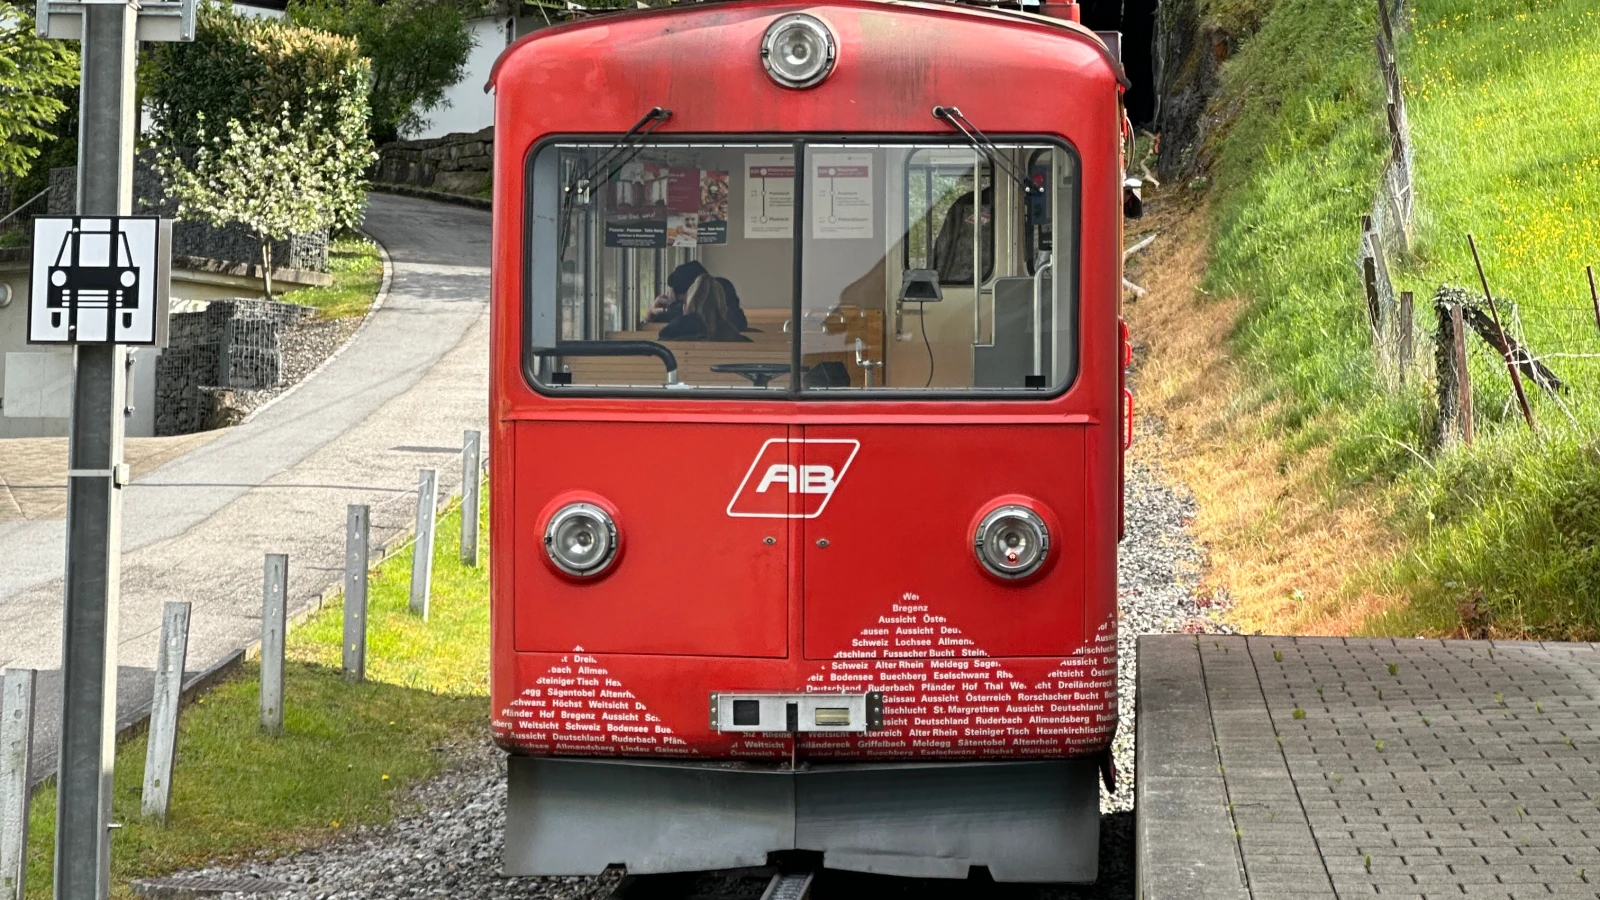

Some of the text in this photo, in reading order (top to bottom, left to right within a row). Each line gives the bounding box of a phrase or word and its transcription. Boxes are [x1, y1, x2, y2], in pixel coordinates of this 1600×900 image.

[755, 464, 835, 493] AB
[892, 604, 928, 613] Bregenz
[878, 615, 916, 624] Aussicht
[940, 626, 962, 634] Deu
[852, 638, 888, 646] Schweiz
[832, 661, 868, 670] Schweiz
[875, 661, 897, 669] Alter
[899, 660, 924, 668] Rhein
[931, 660, 968, 669] Meldegg
[807, 673, 824, 681] eiz
[880, 672, 927, 681] Buechberg
[934, 671, 989, 680] Eselschwanz
[536, 677, 575, 686] Steiniger
[576, 678, 599, 686] Tisch
[1035, 681, 1052, 689] cht
[868, 684, 914, 692] Ruderbach
[921, 683, 955, 691] Pfänder
[962, 682, 978, 690] Hof
[984, 682, 1003, 690] Thal
[522, 689, 541, 697] egg
[548, 688, 595, 697] Sägentobel
[882, 695, 915, 703] Gaissau
[921, 695, 959, 703] Aussicht
[966, 692, 1011, 702] Österreich
[1018, 692, 1072, 701] Rorschacher
[1074, 692, 1099, 700] Bucht
[552, 699, 582, 708] Höchst
[588, 701, 629, 709] Weitsicht
[933, 706, 946, 714] St.
[948, 705, 999, 715] Margrethen
[1006, 704, 1044, 713] Aussicht
[1050, 703, 1104, 712] Deutschland
[540, 710, 555, 718] Hof
[561, 711, 596, 721] Bregenz
[602, 712, 639, 721] Aussicht
[914, 717, 969, 725] Deutschland
[976, 716, 1022, 724] Ruderbach
[1029, 715, 1090, 724] Allmendsberg
[519, 721, 559, 730] Weitsicht
[565, 722, 601, 731] Schweiz
[607, 723, 649, 732] Bodensee
[655, 725, 674, 734] Bue
[964, 728, 1004, 737] Steiniger
[1006, 727, 1030, 736] Tisch
[510, 731, 546, 740] Aussicht
[552, 733, 605, 742] Deutschland
[612, 735, 657, 744] Ruderbach
[744, 741, 785, 749] Weitsicht
[857, 740, 906, 748] Griffelbach
[913, 740, 951, 749] Meldegg
[1012, 738, 1058, 746] Altenrhein
[1065, 736, 1102, 745] Aussicht
[556, 743, 614, 752] Allmendsberg
